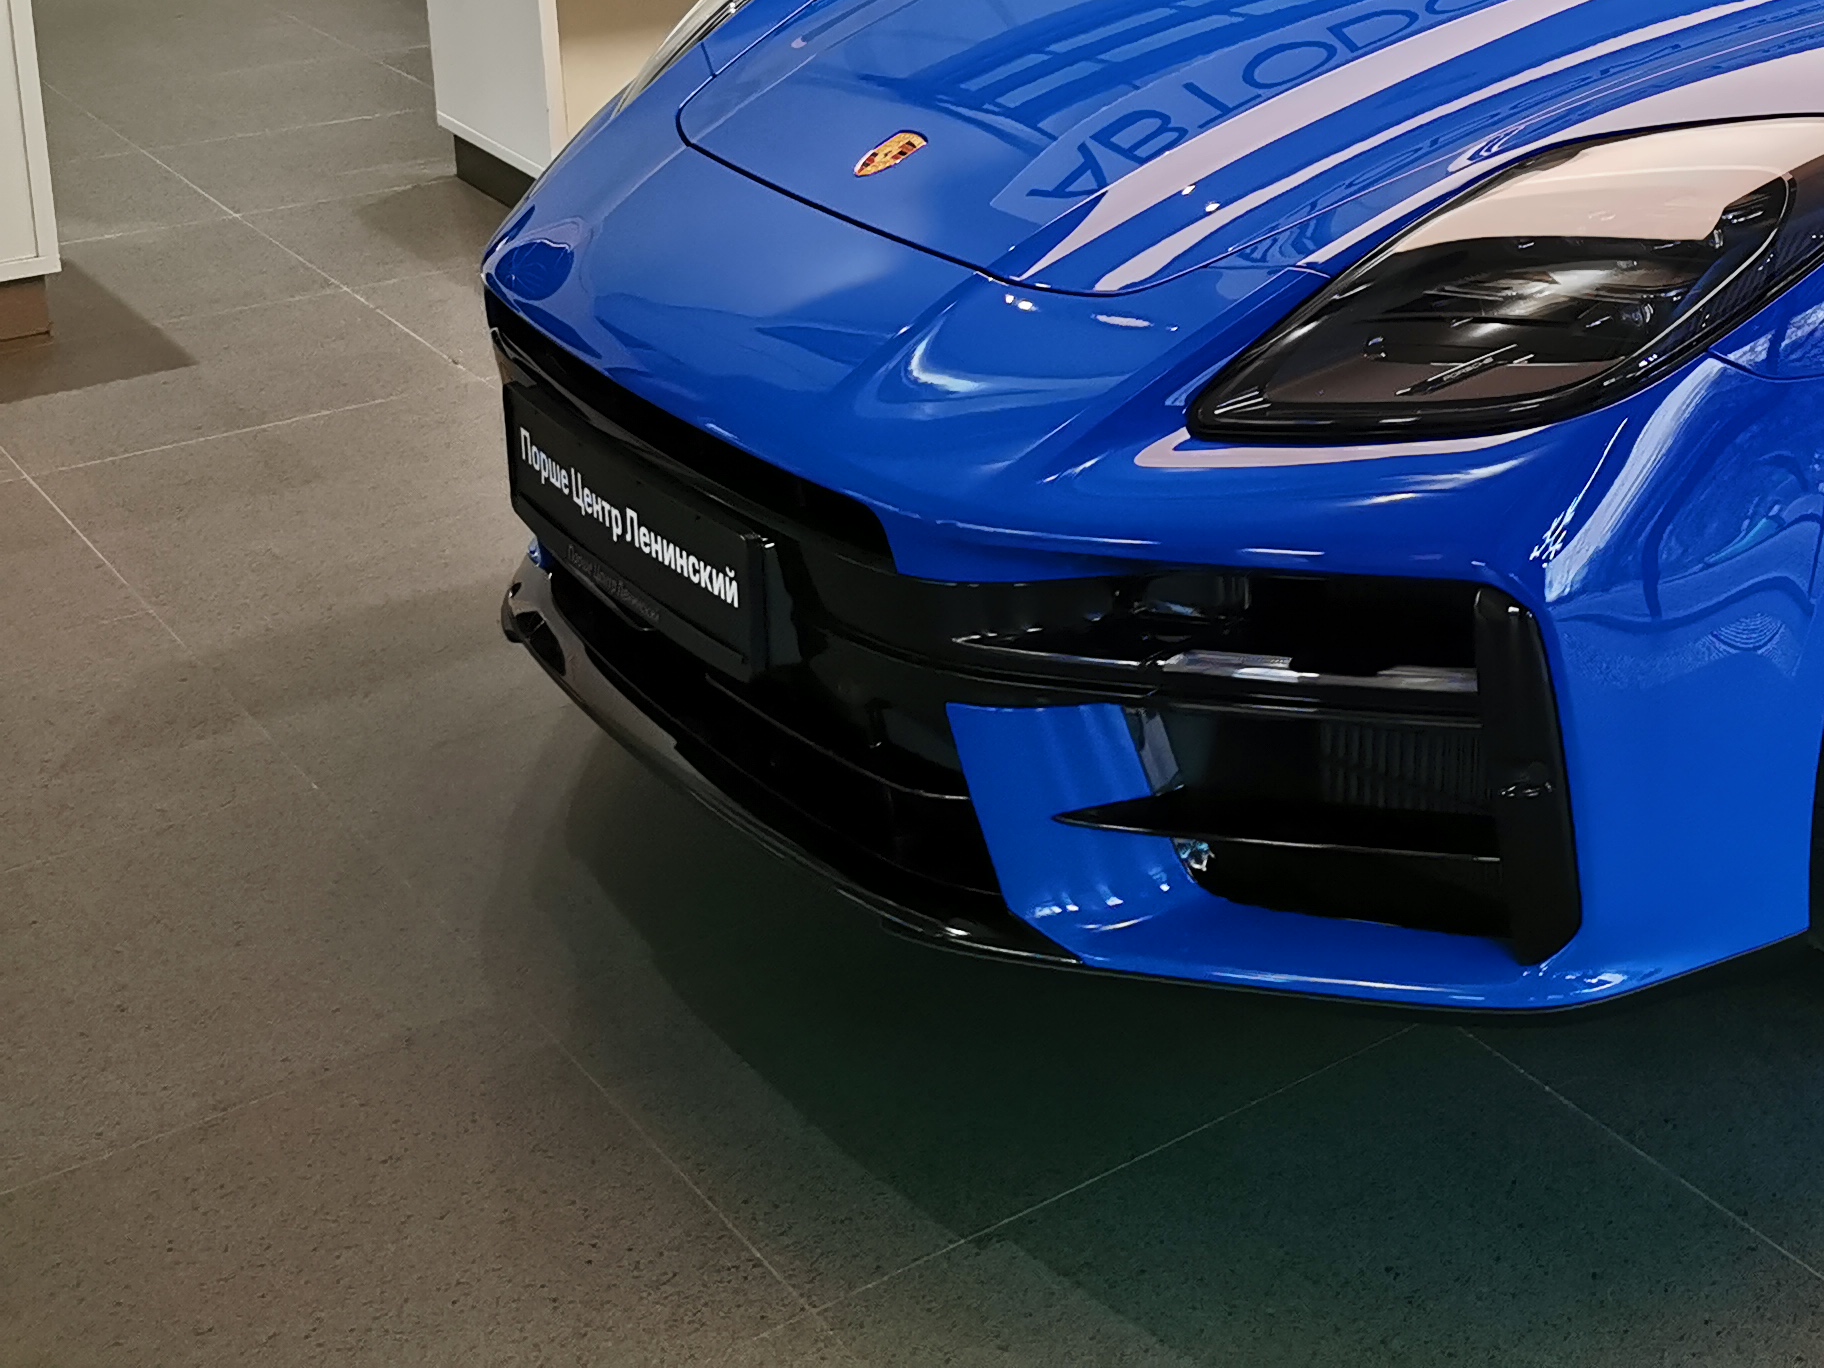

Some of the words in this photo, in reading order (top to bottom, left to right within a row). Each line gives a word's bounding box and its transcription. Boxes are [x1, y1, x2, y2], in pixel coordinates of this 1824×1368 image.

[520, 427, 570, 495] Порше
[571, 467, 623, 542] Центр
[626, 506, 739, 609] Ленинский
